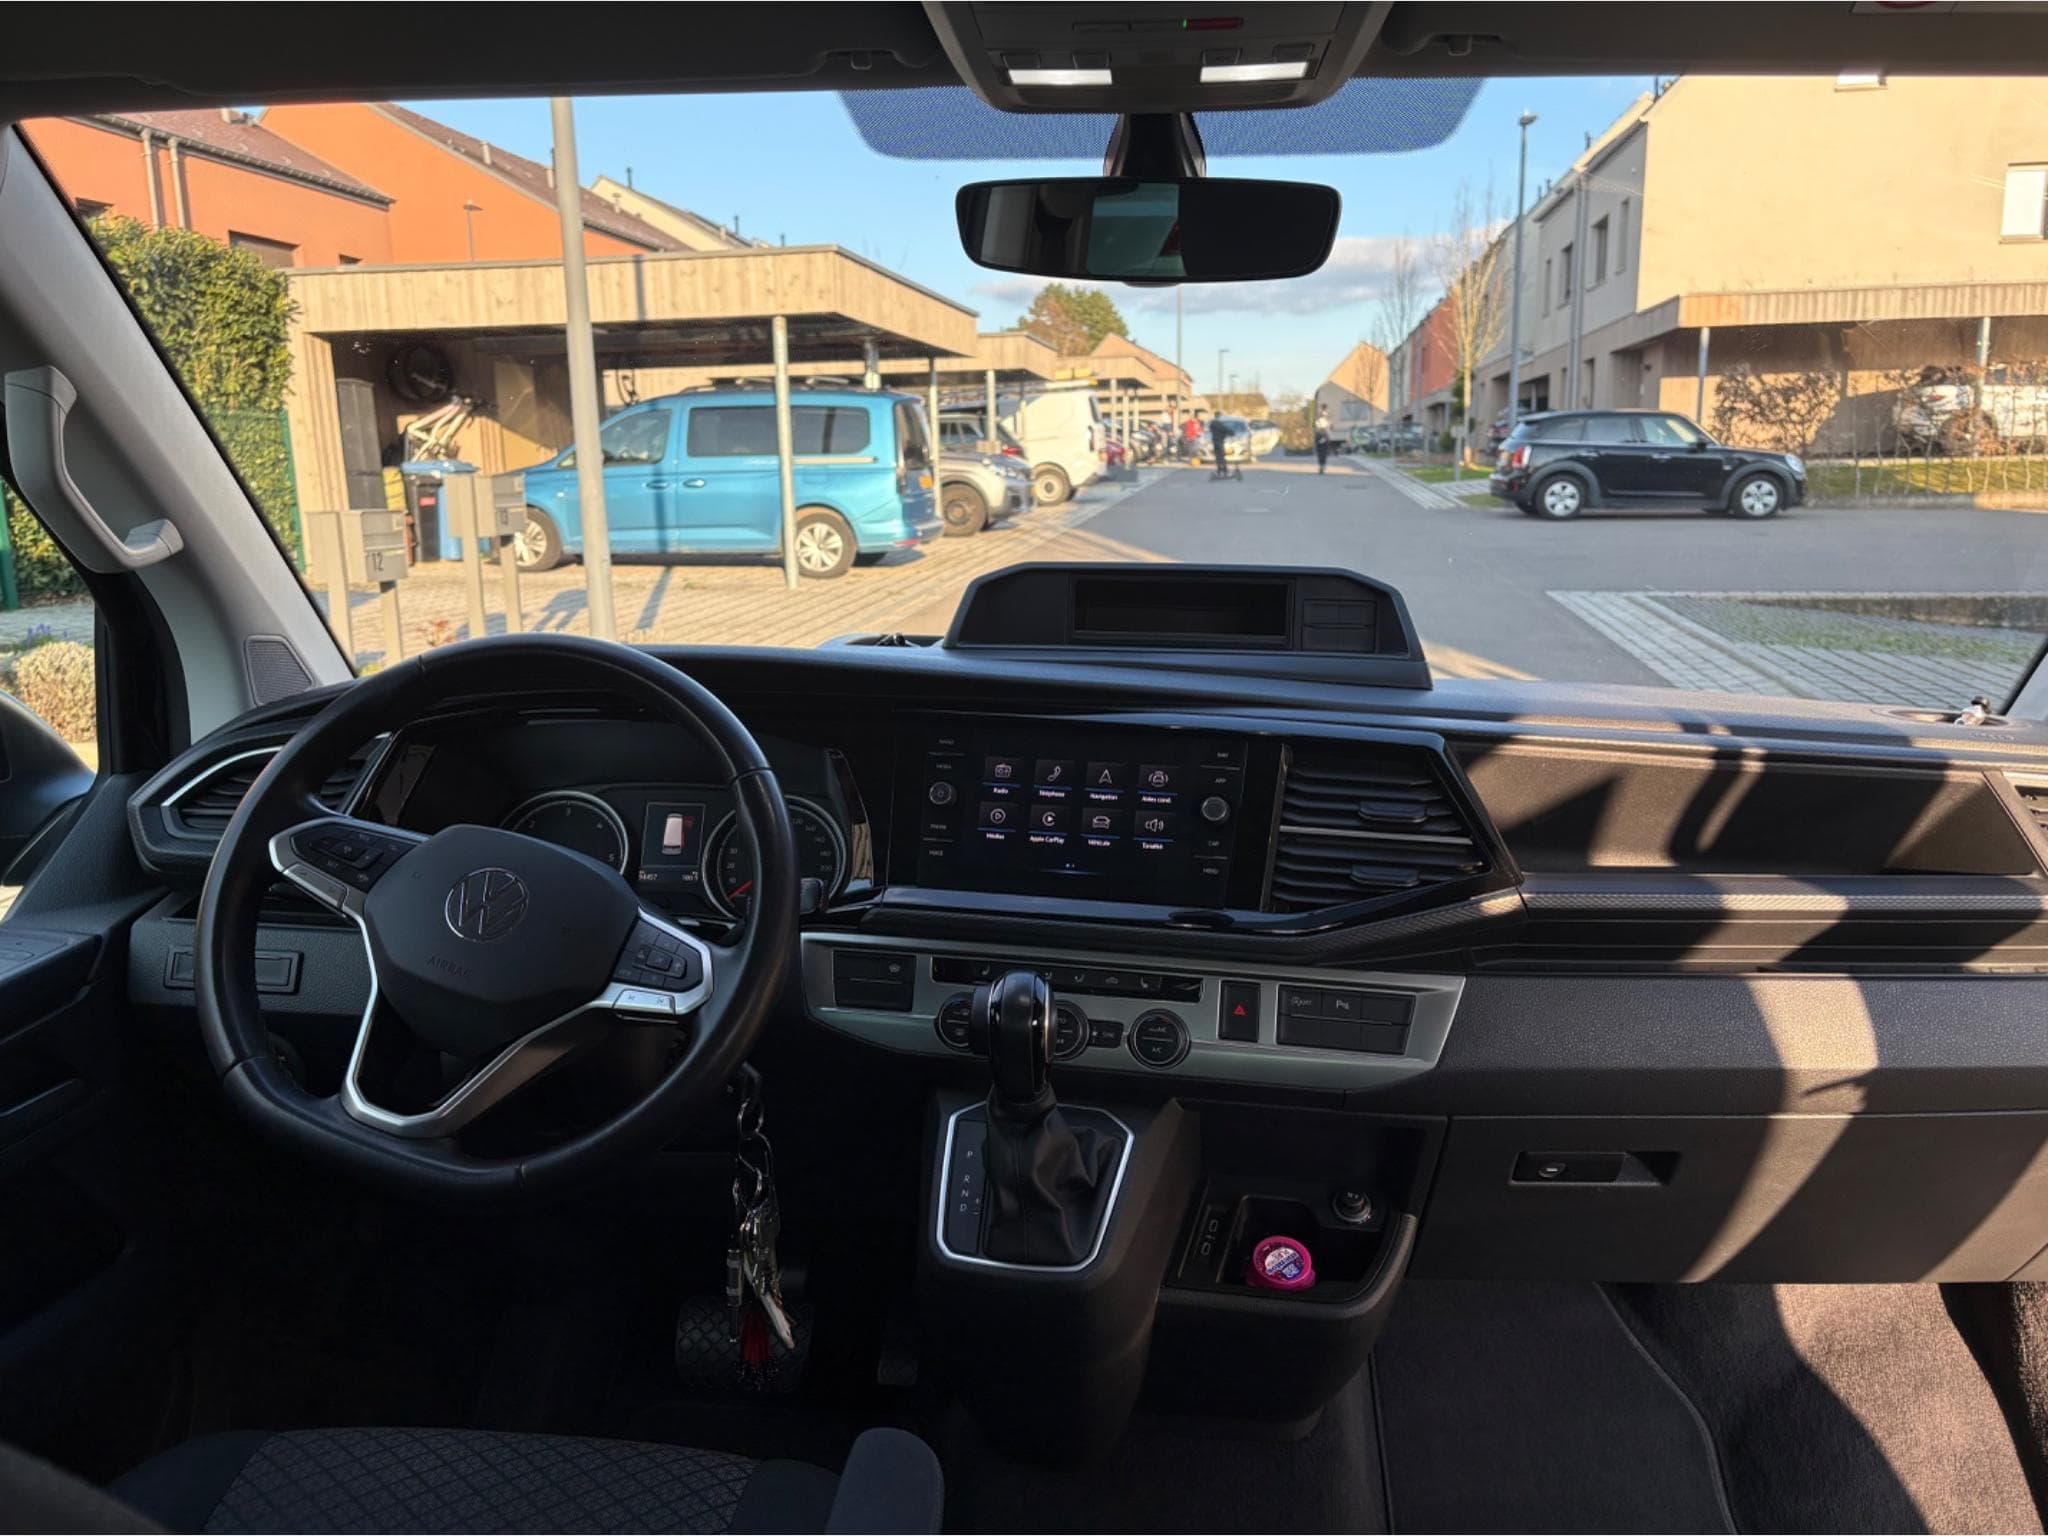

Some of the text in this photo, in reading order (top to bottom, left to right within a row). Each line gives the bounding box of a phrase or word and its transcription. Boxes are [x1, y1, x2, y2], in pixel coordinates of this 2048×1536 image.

[372, 553, 384, 571] 12
[993, 787, 1009, 795] Radio
[1089, 793, 1118, 801] Navigation
[1029, 835, 1065, 845] Apple CarPlay
